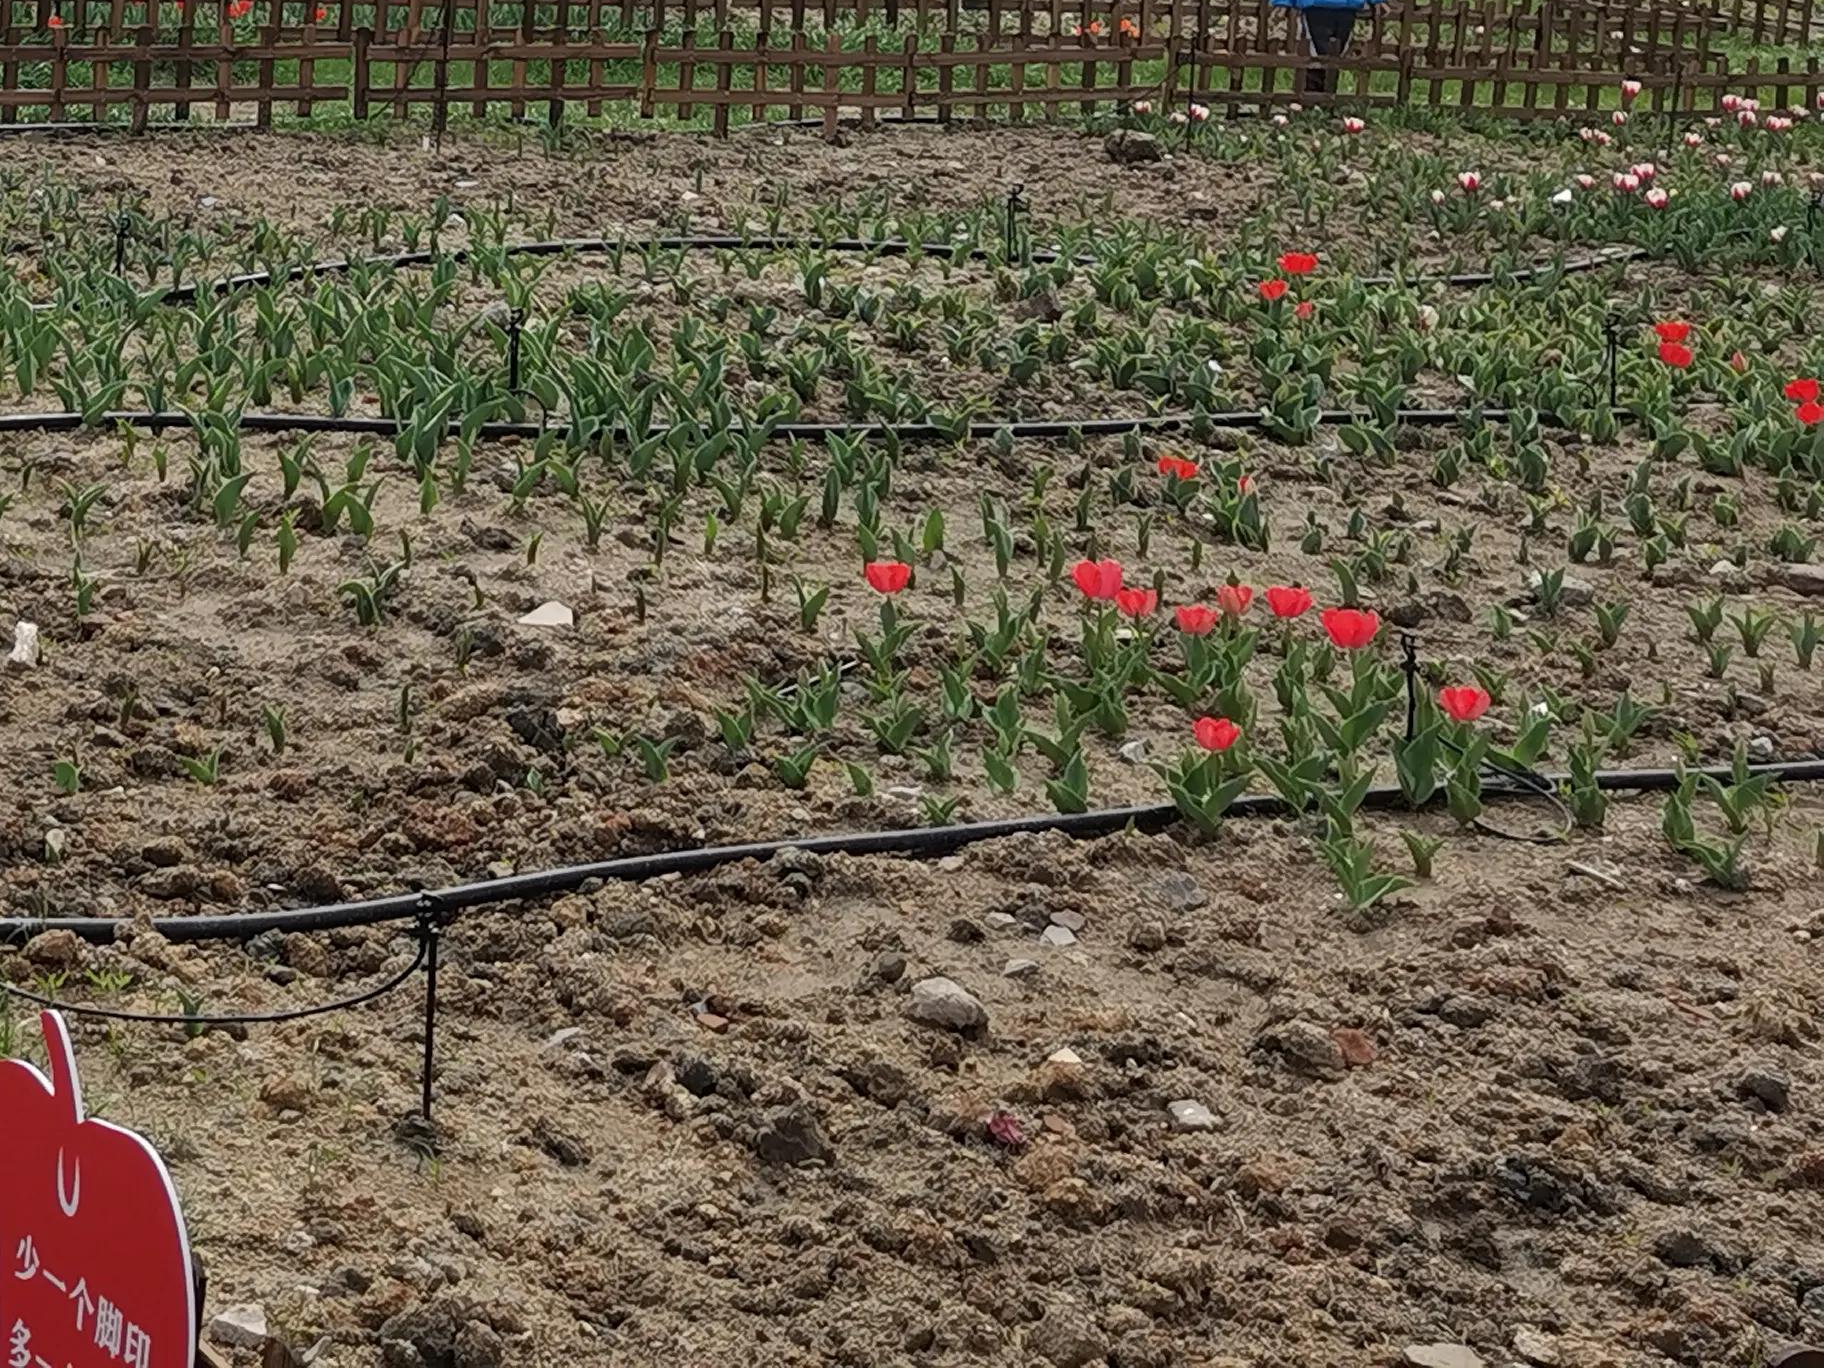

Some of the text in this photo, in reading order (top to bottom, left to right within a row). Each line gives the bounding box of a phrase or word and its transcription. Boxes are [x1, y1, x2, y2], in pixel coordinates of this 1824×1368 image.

[14, 1234, 151, 1368] 少一个脚印
